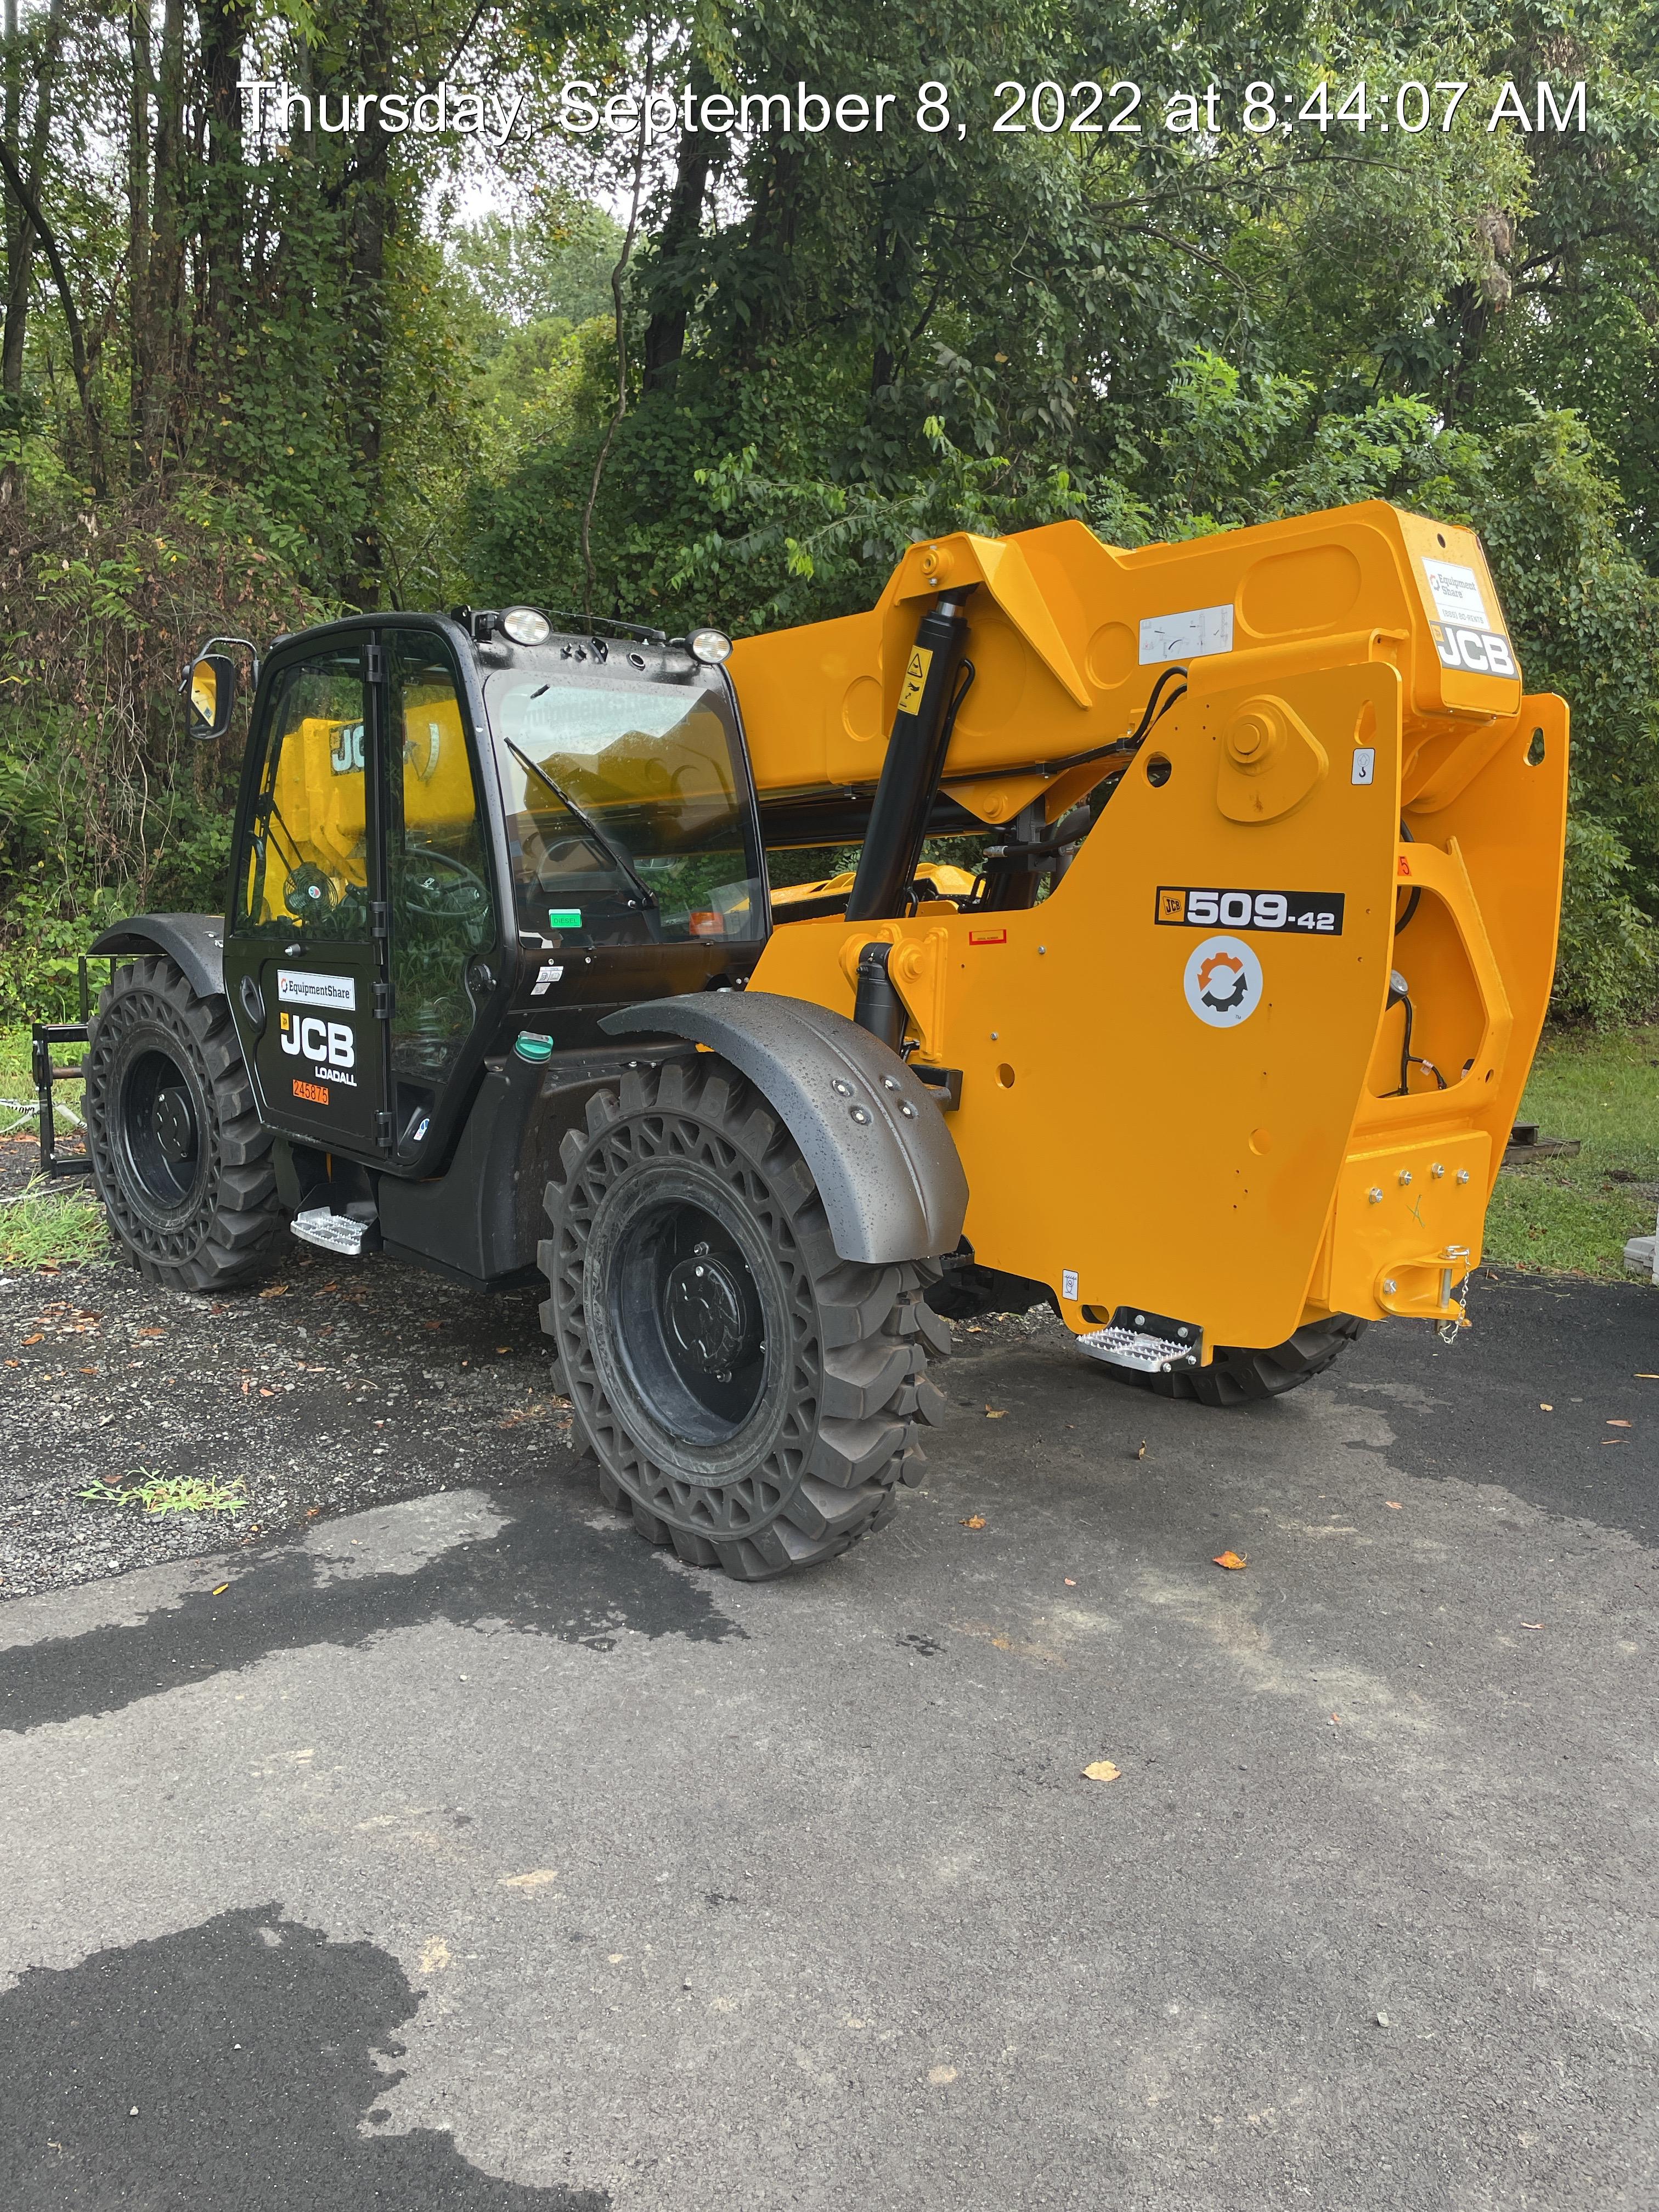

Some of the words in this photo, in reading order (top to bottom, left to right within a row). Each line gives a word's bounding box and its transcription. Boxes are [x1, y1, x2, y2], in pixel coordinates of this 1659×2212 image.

[1437, 574, 1477, 591] Equipment
[1442, 585, 1463, 599] Share
[1437, 627, 1515, 675] JCB
[1166, 899, 1180, 913] JCB
[1187, 891, 1335, 930] 509-42
[289, 980, 350, 998] EquipmentShare
[281, 1015, 355, 1068] JCB
[315, 1066, 357, 1087] LOADALL
[294, 1079, 328, 1103] 245875
